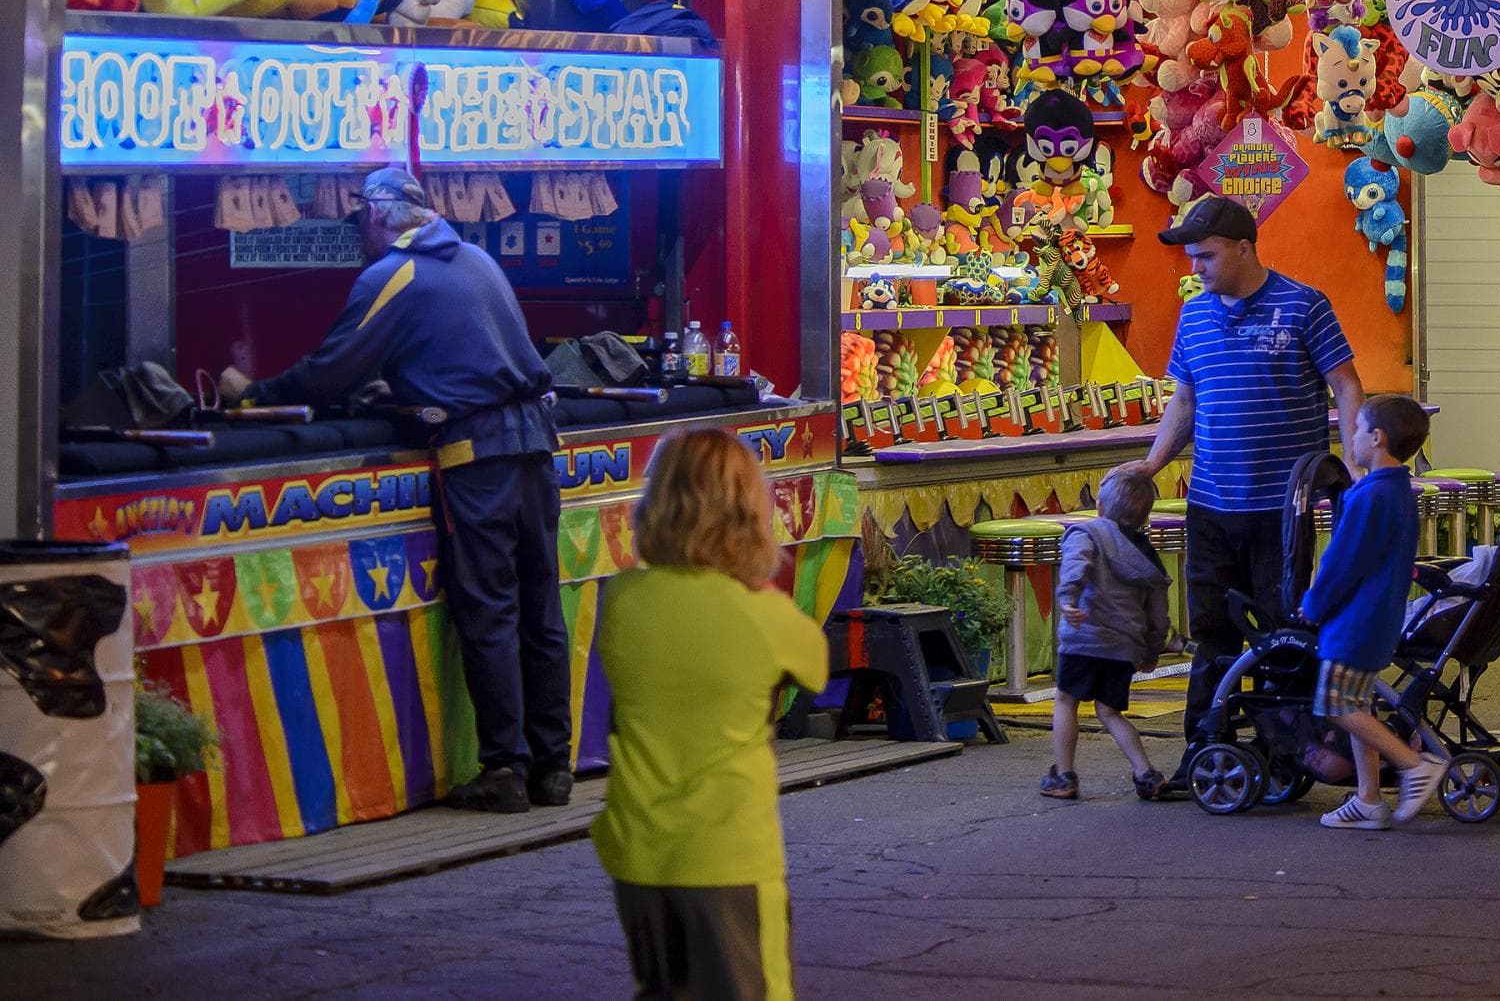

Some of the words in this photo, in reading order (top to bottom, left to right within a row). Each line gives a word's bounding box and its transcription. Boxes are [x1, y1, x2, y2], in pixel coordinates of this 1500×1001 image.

[1416, 21, 1499, 70] FUN
[557, 65, 691, 149] STAR
[1224, 161, 1282, 178] WINS
[855, 312, 862, 330] 8
[896, 311, 903, 328] 9
[936, 310, 945, 327] 10
[1011, 308, 1019, 325] 12
[1047, 307, 1055, 324] 13
[553, 444, 632, 489] UN
[201, 471, 433, 537] MACHI
